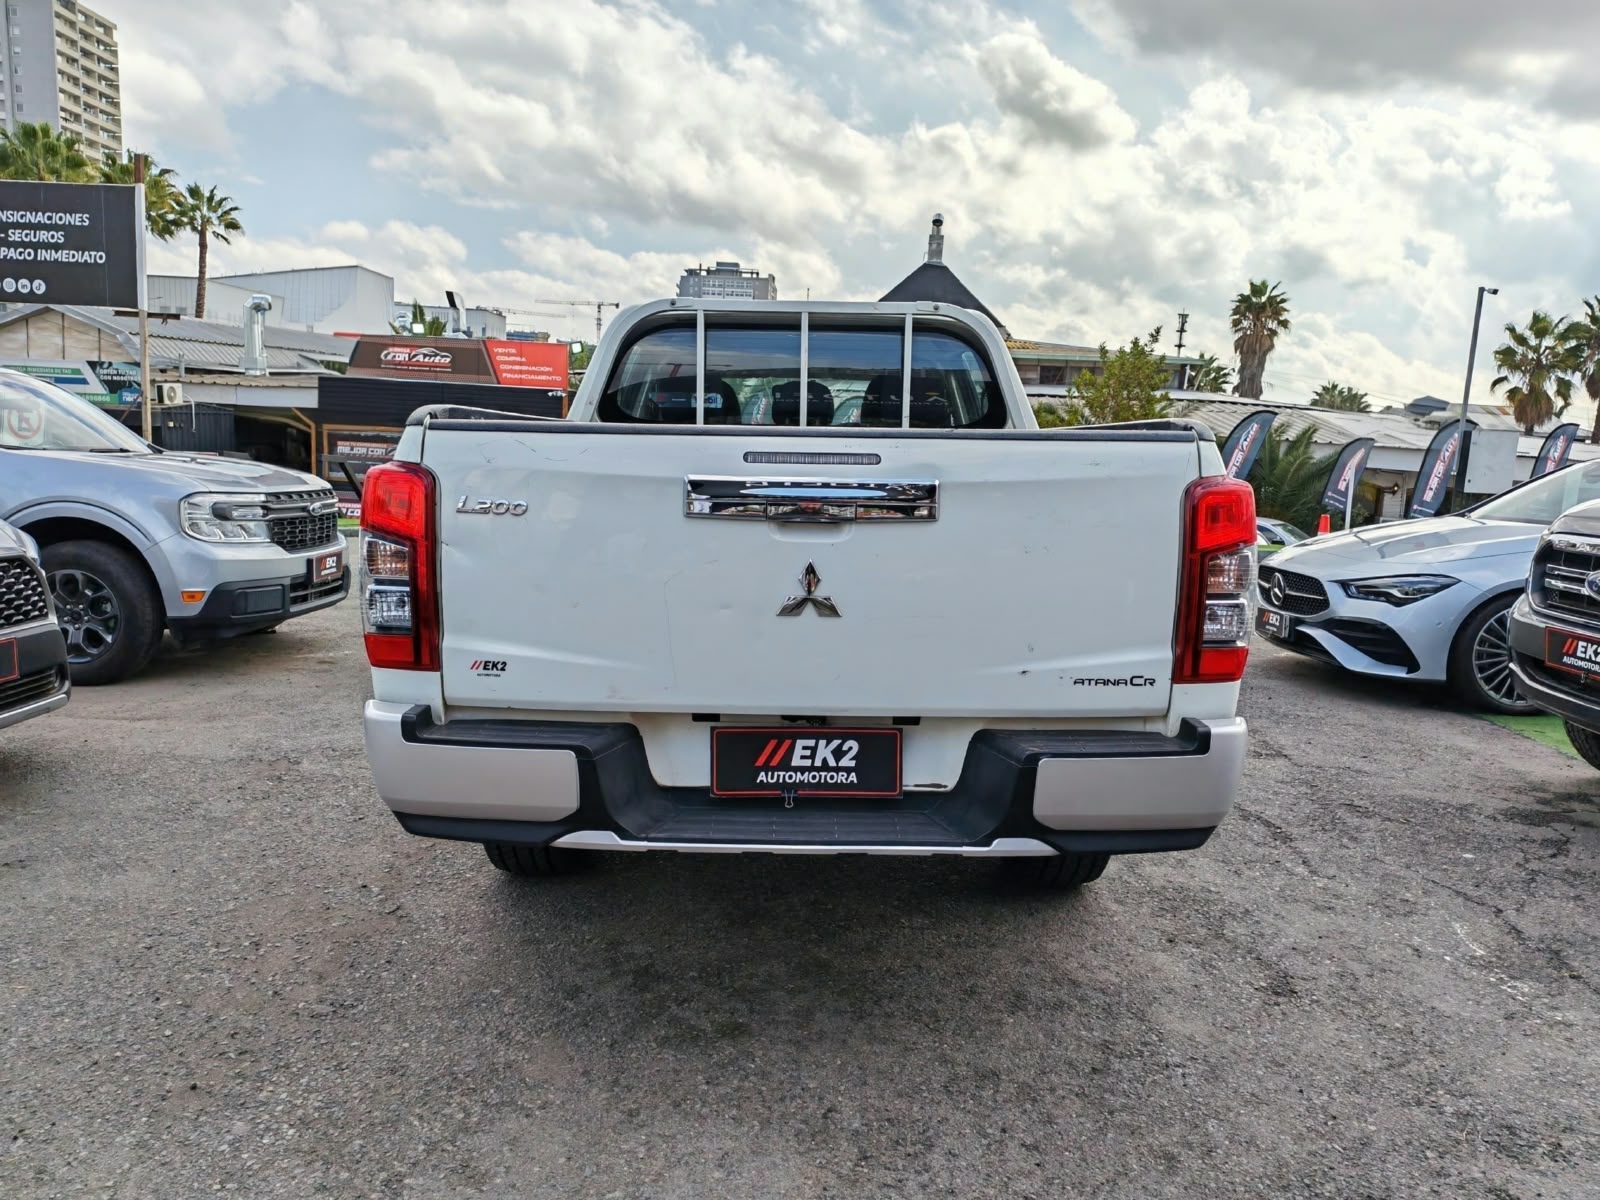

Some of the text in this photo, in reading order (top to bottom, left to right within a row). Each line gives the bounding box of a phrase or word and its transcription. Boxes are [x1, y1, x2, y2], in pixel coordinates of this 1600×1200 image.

[8, 229, 65, 243] SEGUROS
[0, 247, 106, 264] PAGO INMEDIATO
[411, 353, 452, 364] Auto
[502, 372, 562, 382] FINANCIAMIENTO
[346, 508, 361, 516] CO
[456, 495, 528, 516] L200
[1562, 655, 1600, 673] AUTOMOTOR
[756, 771, 858, 784] AUTOMOTORA
